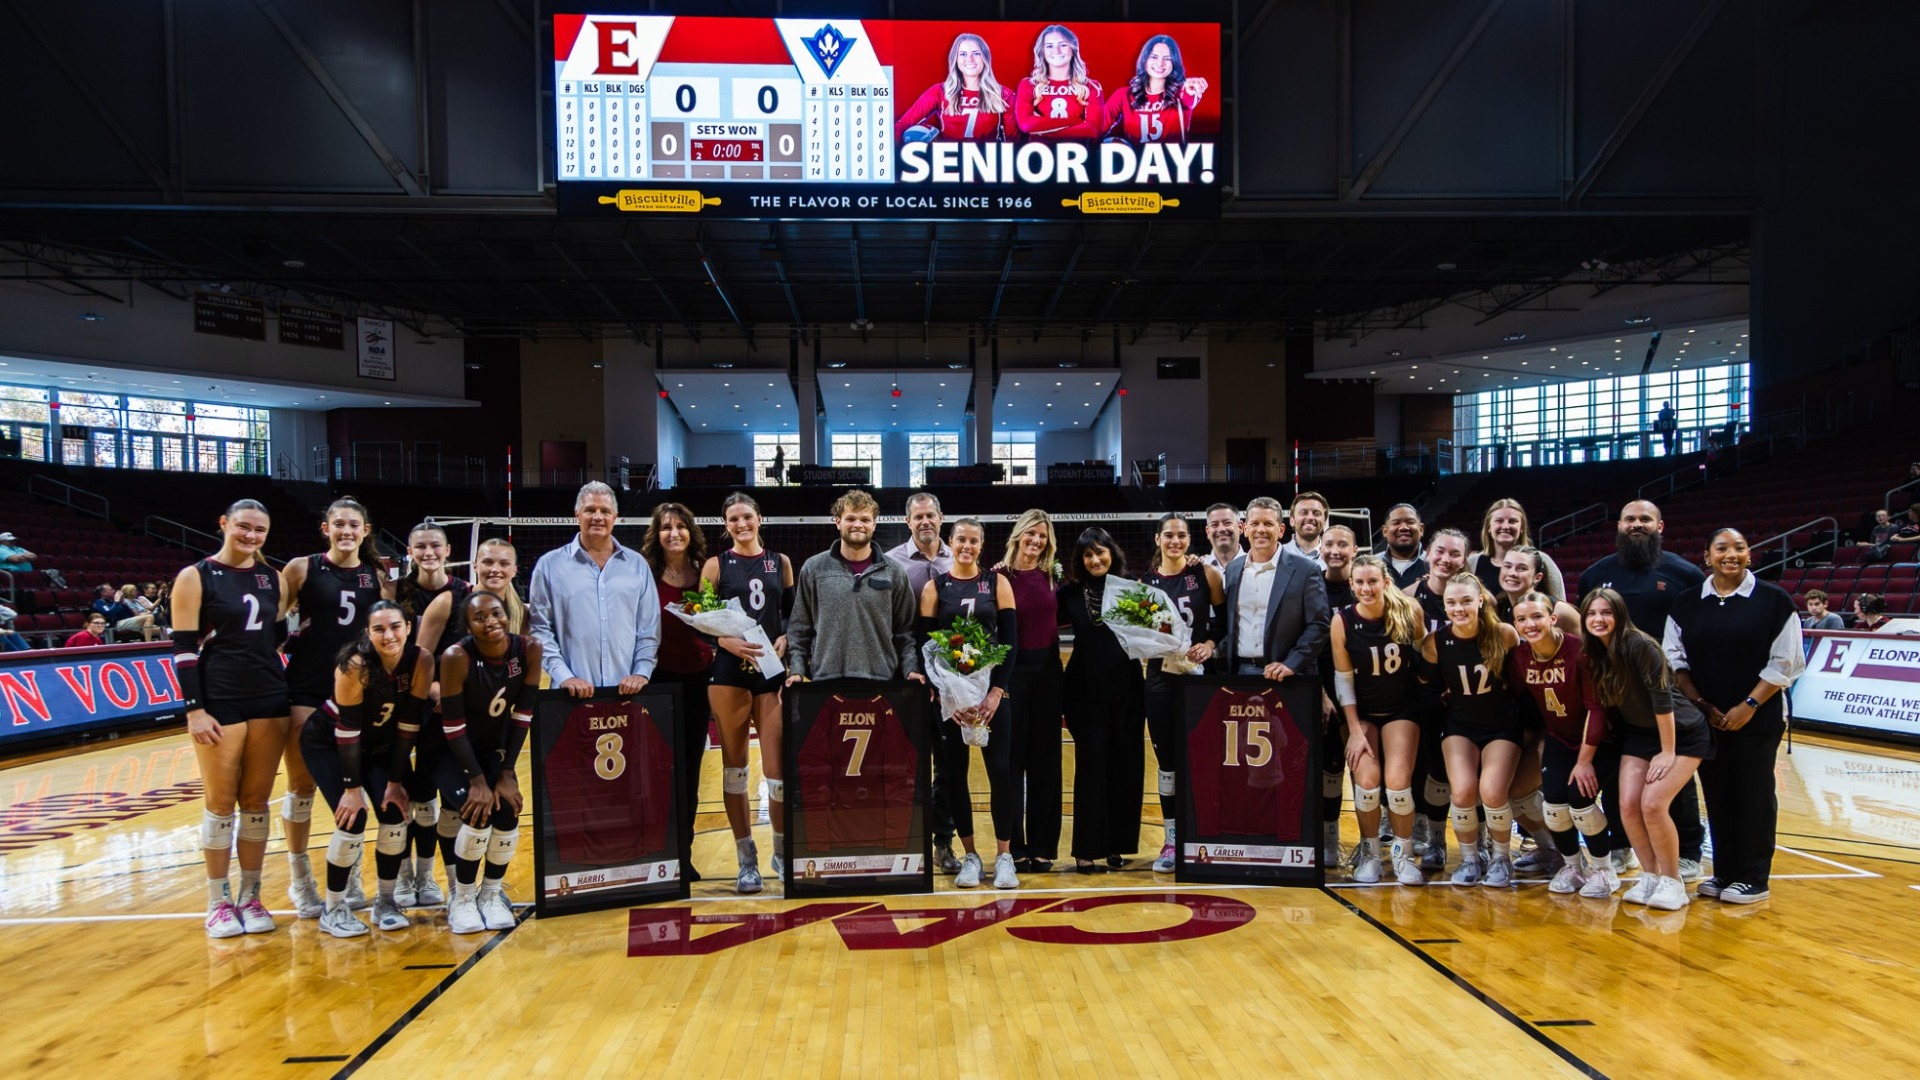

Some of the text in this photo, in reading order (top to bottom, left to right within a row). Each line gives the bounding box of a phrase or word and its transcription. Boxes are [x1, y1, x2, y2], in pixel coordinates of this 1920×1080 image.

[565, 83, 644, 93] # KLS BLK DGS
[811, 87, 889, 96] # KLS BLK DGS
[675, 84, 697, 112] 0
[757, 85, 779, 114] 0
[566, 101, 571, 109] 8
[612, 102, 617, 110] 0
[635, 102, 640, 110] 0
[834, 105, 839, 113] 0
[856, 105, 862, 113] 0
[879, 105, 883, 113] 0
[1050, 98, 1068, 118] 8
[567, 113, 572, 122] 9
[589, 114, 594, 122] 0
[612, 114, 617, 122] 0
[812, 117, 817, 125] 4
[879, 118, 883, 126] 0
[962, 108, 978, 138] 7
[566, 126, 573, 134] 11
[612, 127, 617, 135] 0
[697, 125, 757, 135] SETS WON
[835, 130, 840, 138] 0
[857, 130, 862, 138] 0
[879, 130, 883, 138] 0
[1139, 114, 1163, 143] 15
[566, 139, 641, 148] 12 0 0 0
[661, 134, 677, 156] 0
[779, 134, 794, 156] 0
[811, 142, 820, 150] 11
[835, 142, 840, 150] 0
[879, 143, 884, 151] 0
[566, 152, 574, 160] 15
[590, 152, 595, 160] 0
[613, 152, 618, 160] 0
[713, 144, 741, 158] 0:00
[835, 154, 840, 162] 0
[566, 165, 641, 174] 17 0 0 0
[900, 142, 1214, 183] SENIOR DAY!
[811, 168, 884, 176] 14 0 0 0
[624, 193, 696, 206] Biscuitville
[750, 196, 1032, 208] THE FLAVOR OF LOCAL SINCE 1966
[1087, 194, 1155, 208] Biscuitville
[369, 346, 385, 354] NDA
[369, 369, 385, 377] 2022
[803, 469, 869, 480] STUDENT SECTION
[1049, 468, 1112, 479] STUDENT SECTION
[749, 578, 765, 610] 8
[243, 594, 263, 631] 2
[337, 590, 356, 626] 5
[960, 598, 976, 619] 7
[1370, 643, 1402, 676] 18
[1819, 640, 1852, 673] E
[1868, 648, 1920, 662] ELONP
[1458, 664, 1492, 695] 12
[1526, 667, 1566, 685] ELON
[488, 686, 507, 717] 6
[1544, 688, 1568, 716] 4
[1824, 690, 1843, 702] THE
[1846, 693, 1897, 707] OFFICIAL
[373, 702, 395, 727] 3
[1229, 705, 1265, 717] ELON
[1843, 704, 1874, 718] ELON
[589, 715, 628, 731] ELON
[839, 713, 875, 726] ELON
[1222, 720, 1273, 767] 15
[594, 733, 626, 780] 8
[842, 729, 872, 776] 7
[1213, 849, 1245, 857] CARLSEN
[1290, 849, 1303, 863] 15
[823, 861, 857, 870] SIMMONS
[902, 857, 910, 871] 7
[658, 864, 667, 879] 8
[577, 874, 605, 885] HARRIS
